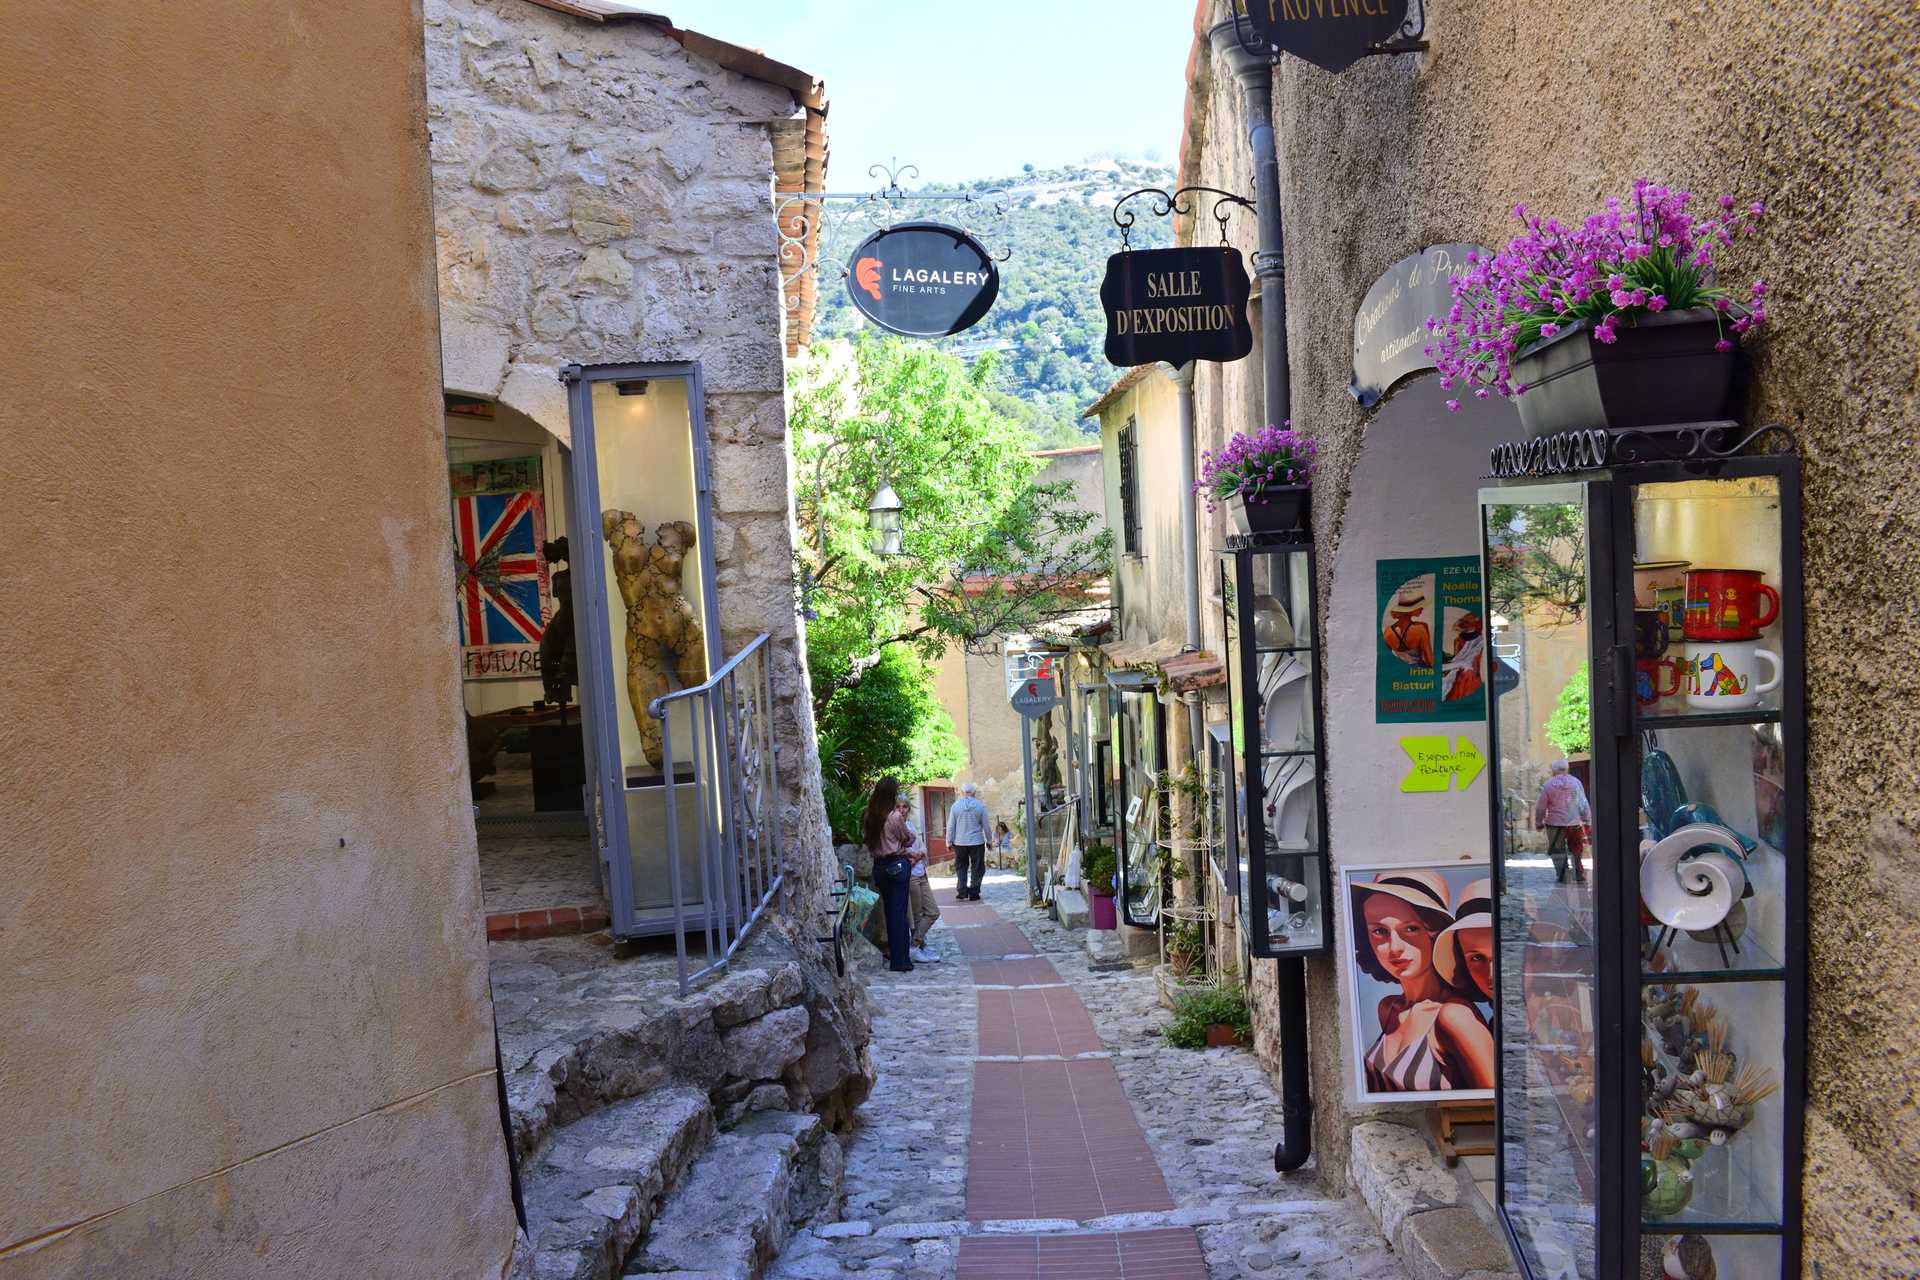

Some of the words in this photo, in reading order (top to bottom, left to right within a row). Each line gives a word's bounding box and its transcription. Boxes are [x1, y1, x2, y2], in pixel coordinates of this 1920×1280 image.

[892, 268, 989, 286] LAGALERY
[892, 285, 916, 294] FINE
[919, 286, 946, 295] ARTS
[1147, 270, 1202, 298] SALLE
[1115, 304, 1235, 336] D'EXPOSITION
[466, 650, 543, 676] FUTURE
